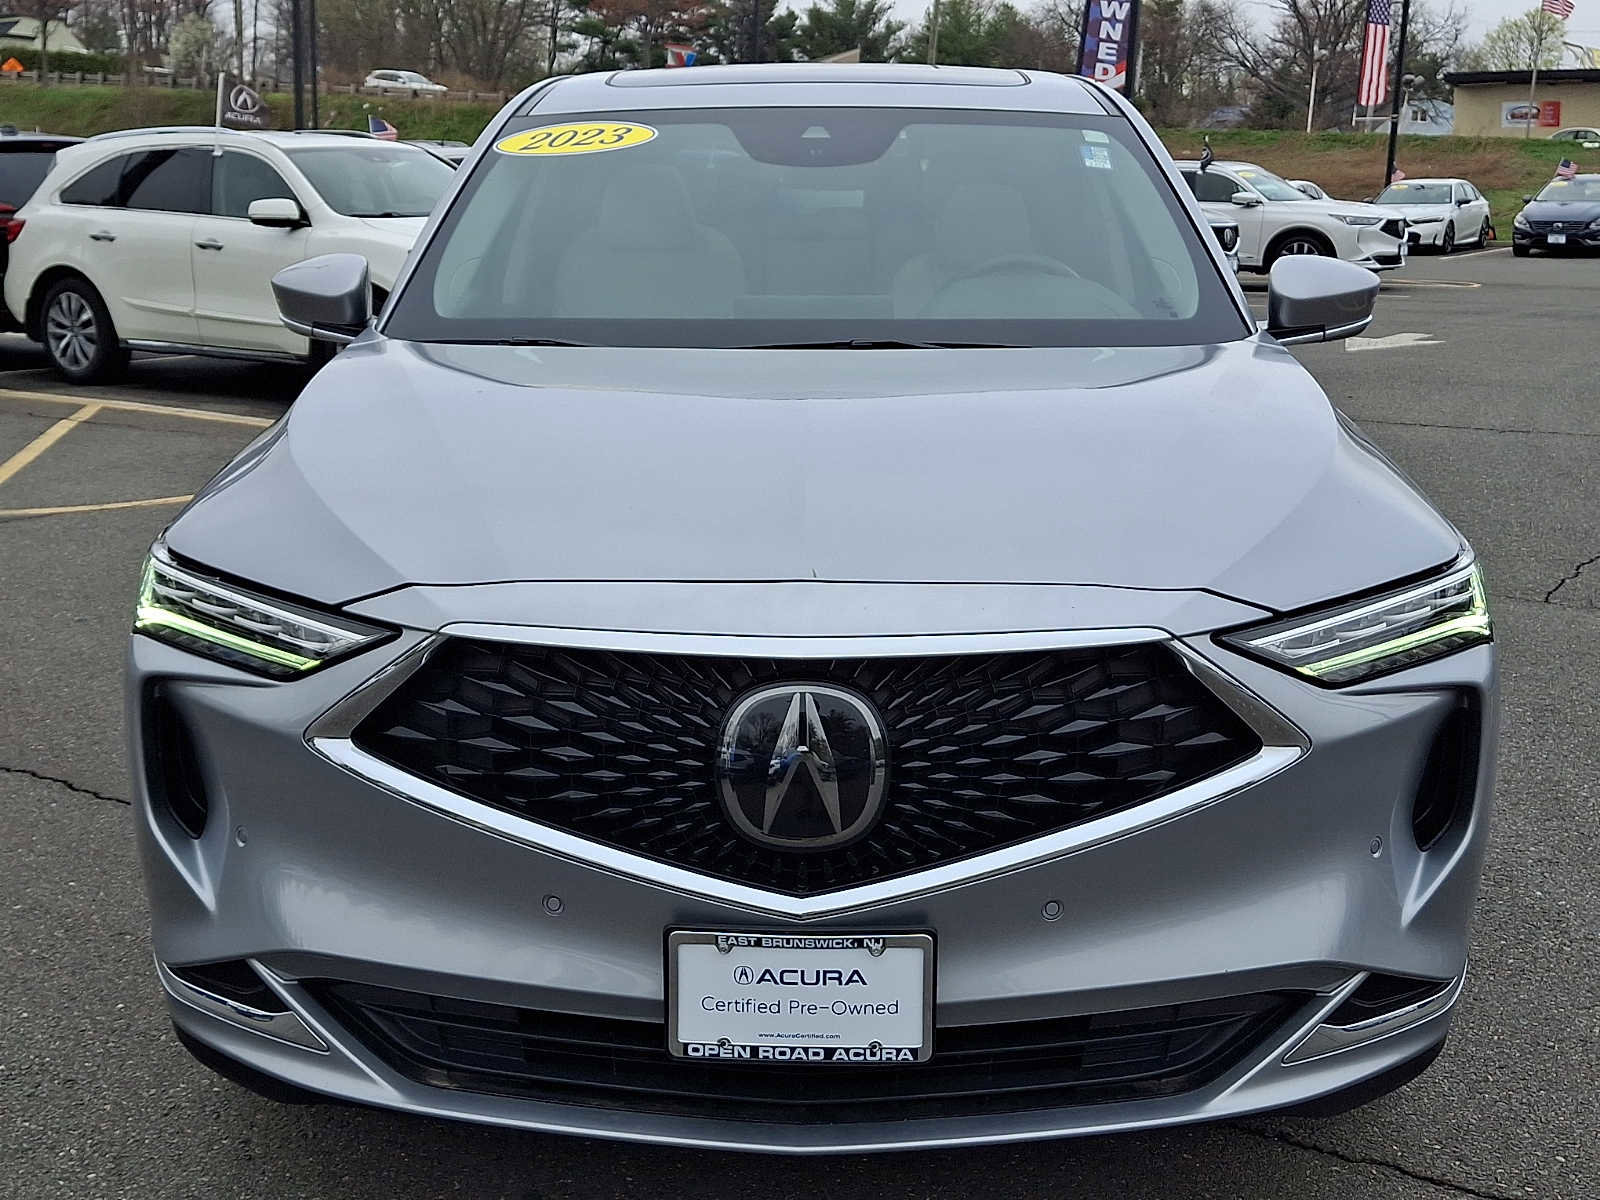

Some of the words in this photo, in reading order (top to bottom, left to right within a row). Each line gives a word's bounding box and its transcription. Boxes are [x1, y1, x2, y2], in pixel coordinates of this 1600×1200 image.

[518, 127, 633, 151] 2023
[717, 935, 757, 947] EAST
[863, 938, 884, 949] NJ
[756, 969, 868, 986] ACURA
[700, 996, 781, 1015] Certified
[789, 999, 899, 1016] Pre-Owned
[758, 1031, 841, 1040] www.AcuraCertified.com
[687, 1043, 751, 1058] OPEN
[758, 1046, 824, 1060] ROAD
[832, 1048, 914, 1061] ACURA
